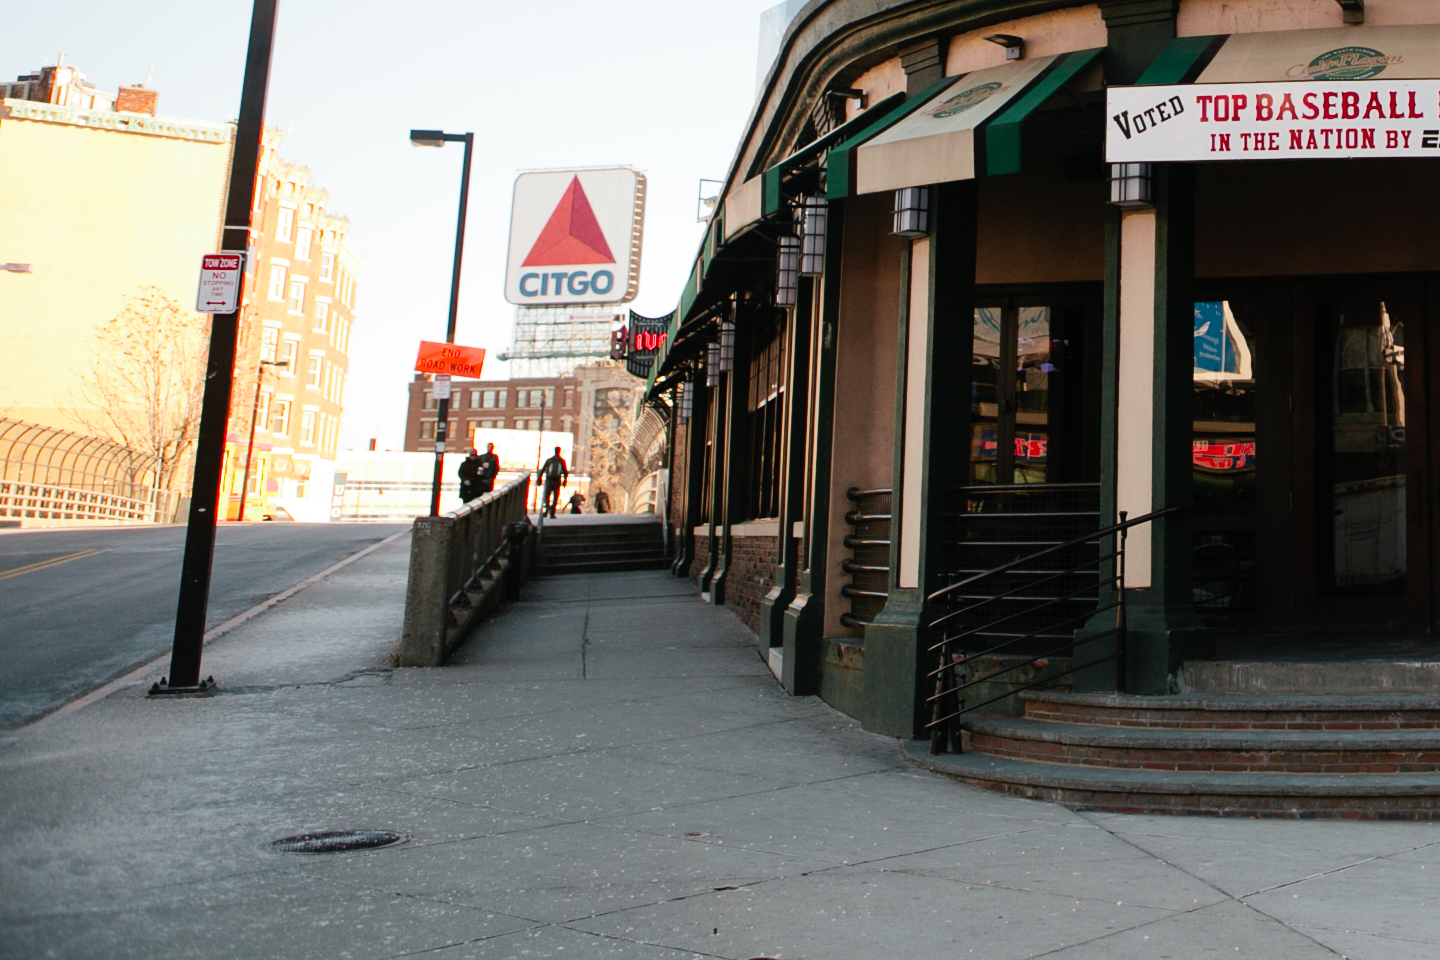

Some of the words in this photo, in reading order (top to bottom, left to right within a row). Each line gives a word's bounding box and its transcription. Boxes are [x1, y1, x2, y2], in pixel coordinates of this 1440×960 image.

[9, 101, 77, 125] HOTEL
[1196, 94, 1248, 123] TOP
[1255, 90, 1424, 123] BASEBALL
[1210, 133, 1232, 152] IN
[1240, 132, 1281, 152] THE
[1288, 128, 1377, 152] NATION
[1385, 129, 1412, 150] BY
[205, 258, 219, 268] TOW
[219, 258, 238, 268] ZONE
[518, 269, 614, 297] CITGO
[441, 347, 461, 359] END
[420, 358, 446, 371] ROAD
[450, 362, 476, 374] WORK
[330, 484, 346, 518] UNO
